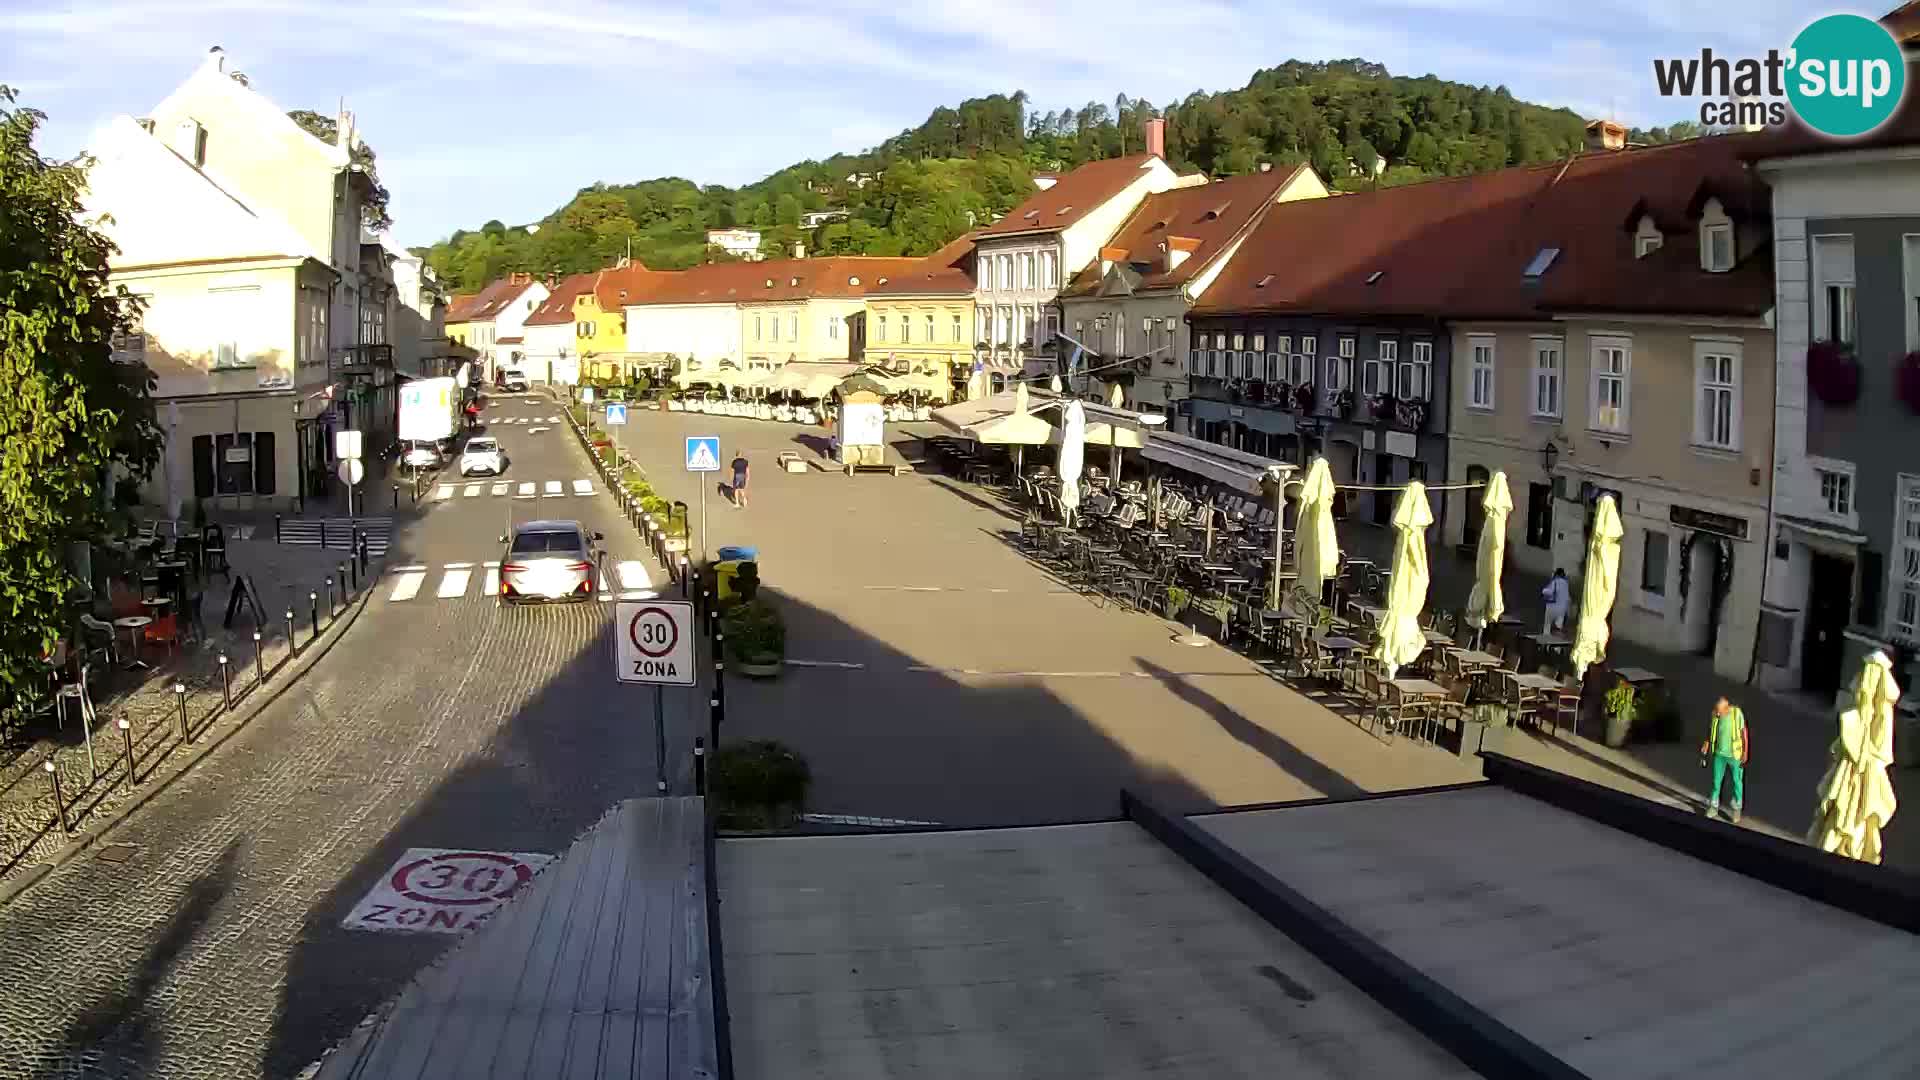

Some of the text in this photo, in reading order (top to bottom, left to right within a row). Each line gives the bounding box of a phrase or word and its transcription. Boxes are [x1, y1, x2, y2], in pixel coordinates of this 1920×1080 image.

[643, 623, 667, 644] 30
[633, 661, 677, 676] ZONA
[419, 865, 504, 892] 30
